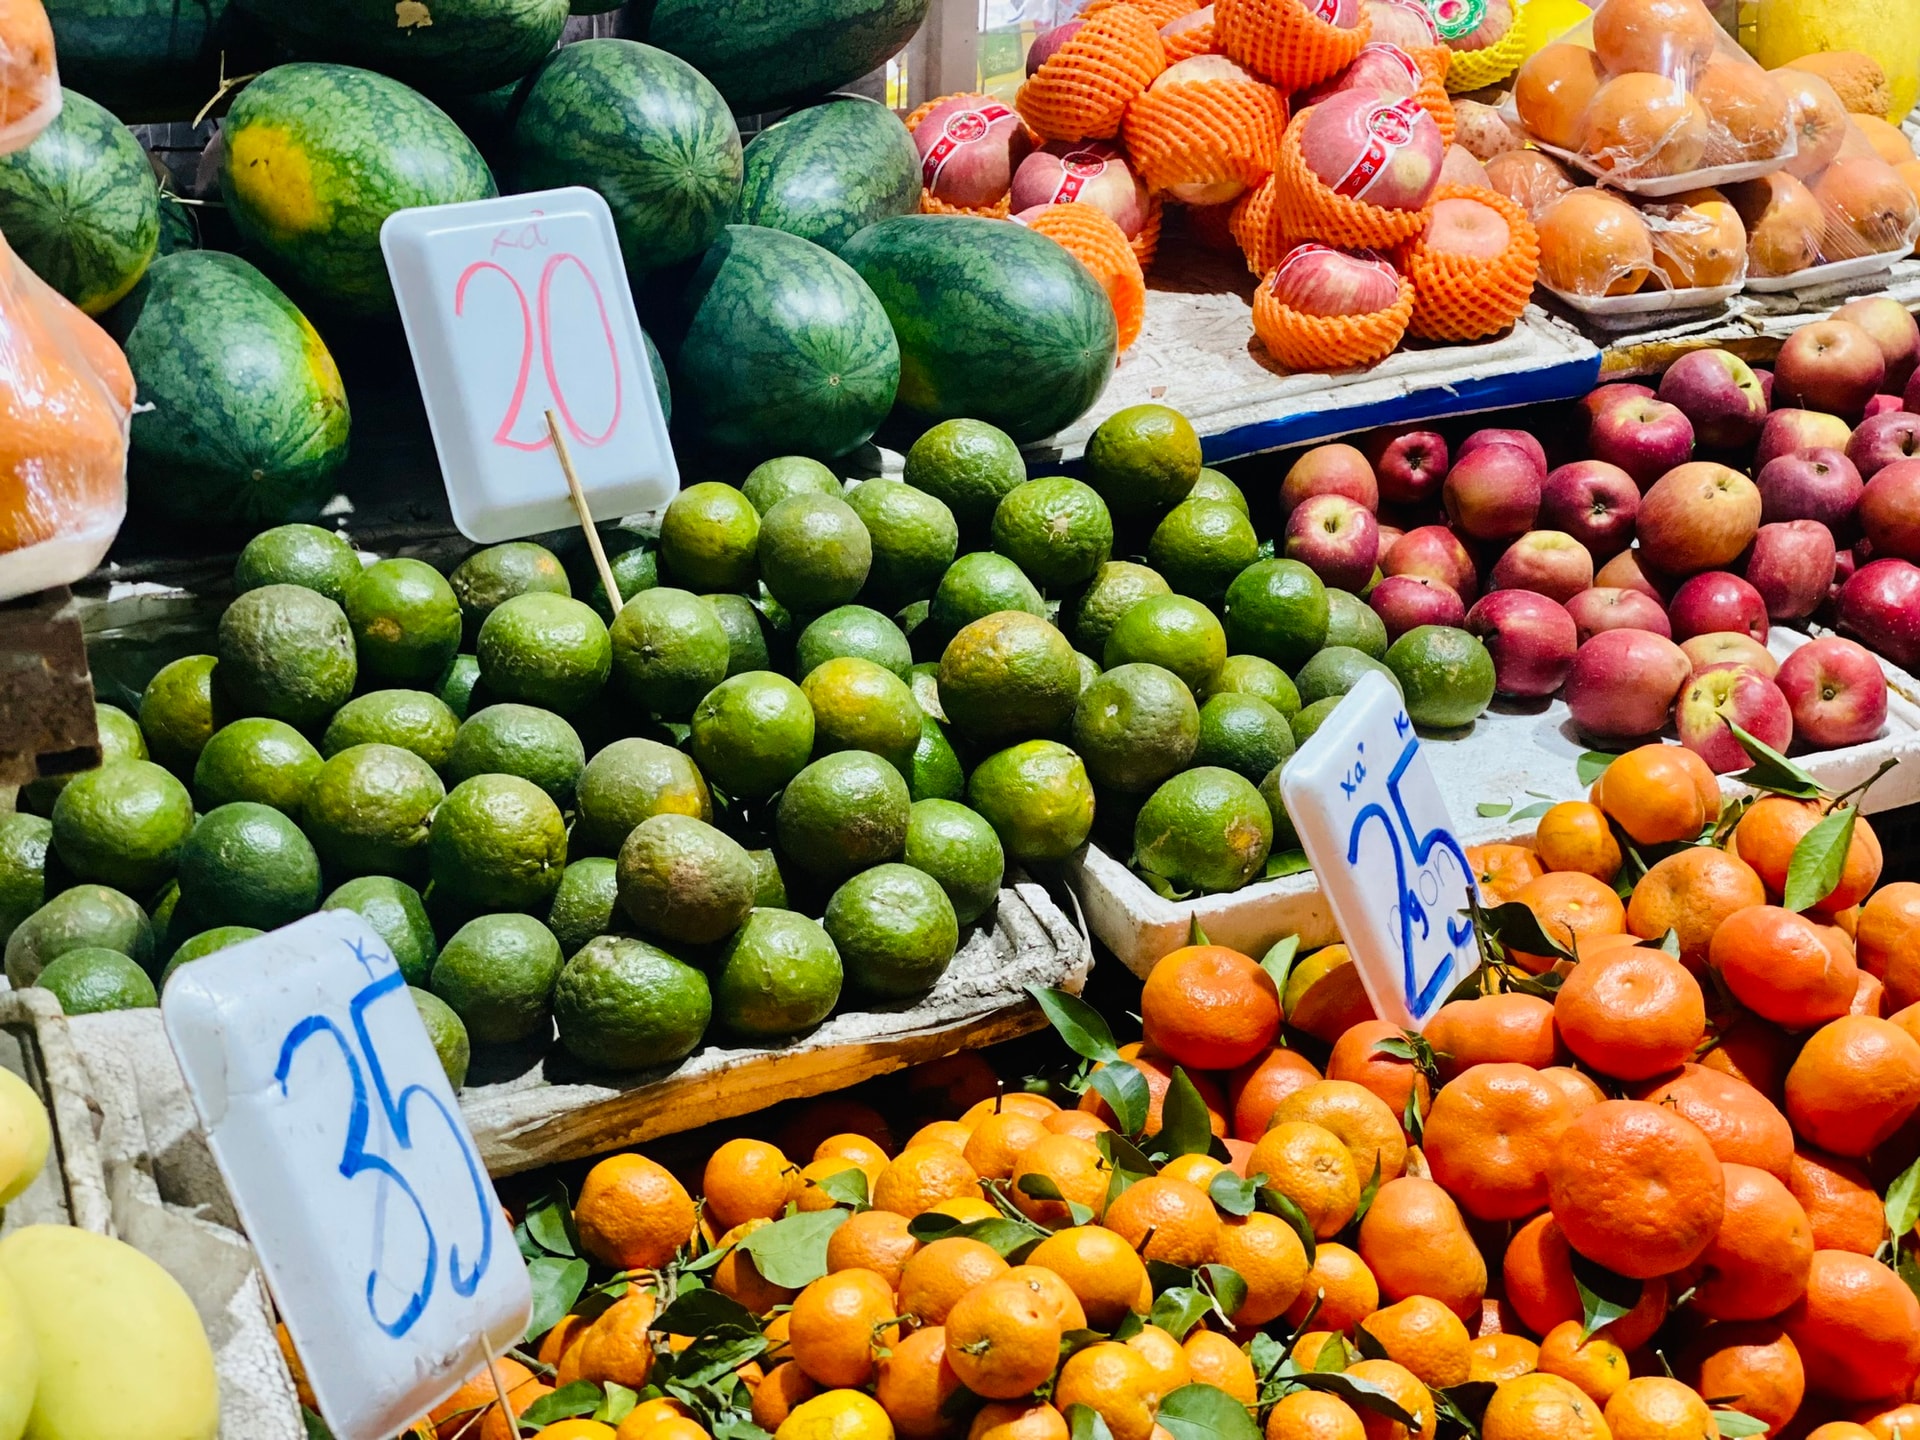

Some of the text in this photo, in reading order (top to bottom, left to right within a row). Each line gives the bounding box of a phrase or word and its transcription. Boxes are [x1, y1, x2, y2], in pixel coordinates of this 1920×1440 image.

[455, 252, 622, 452] 20
[1346, 736, 1480, 1019] 25
[275, 969, 493, 1340] 35
